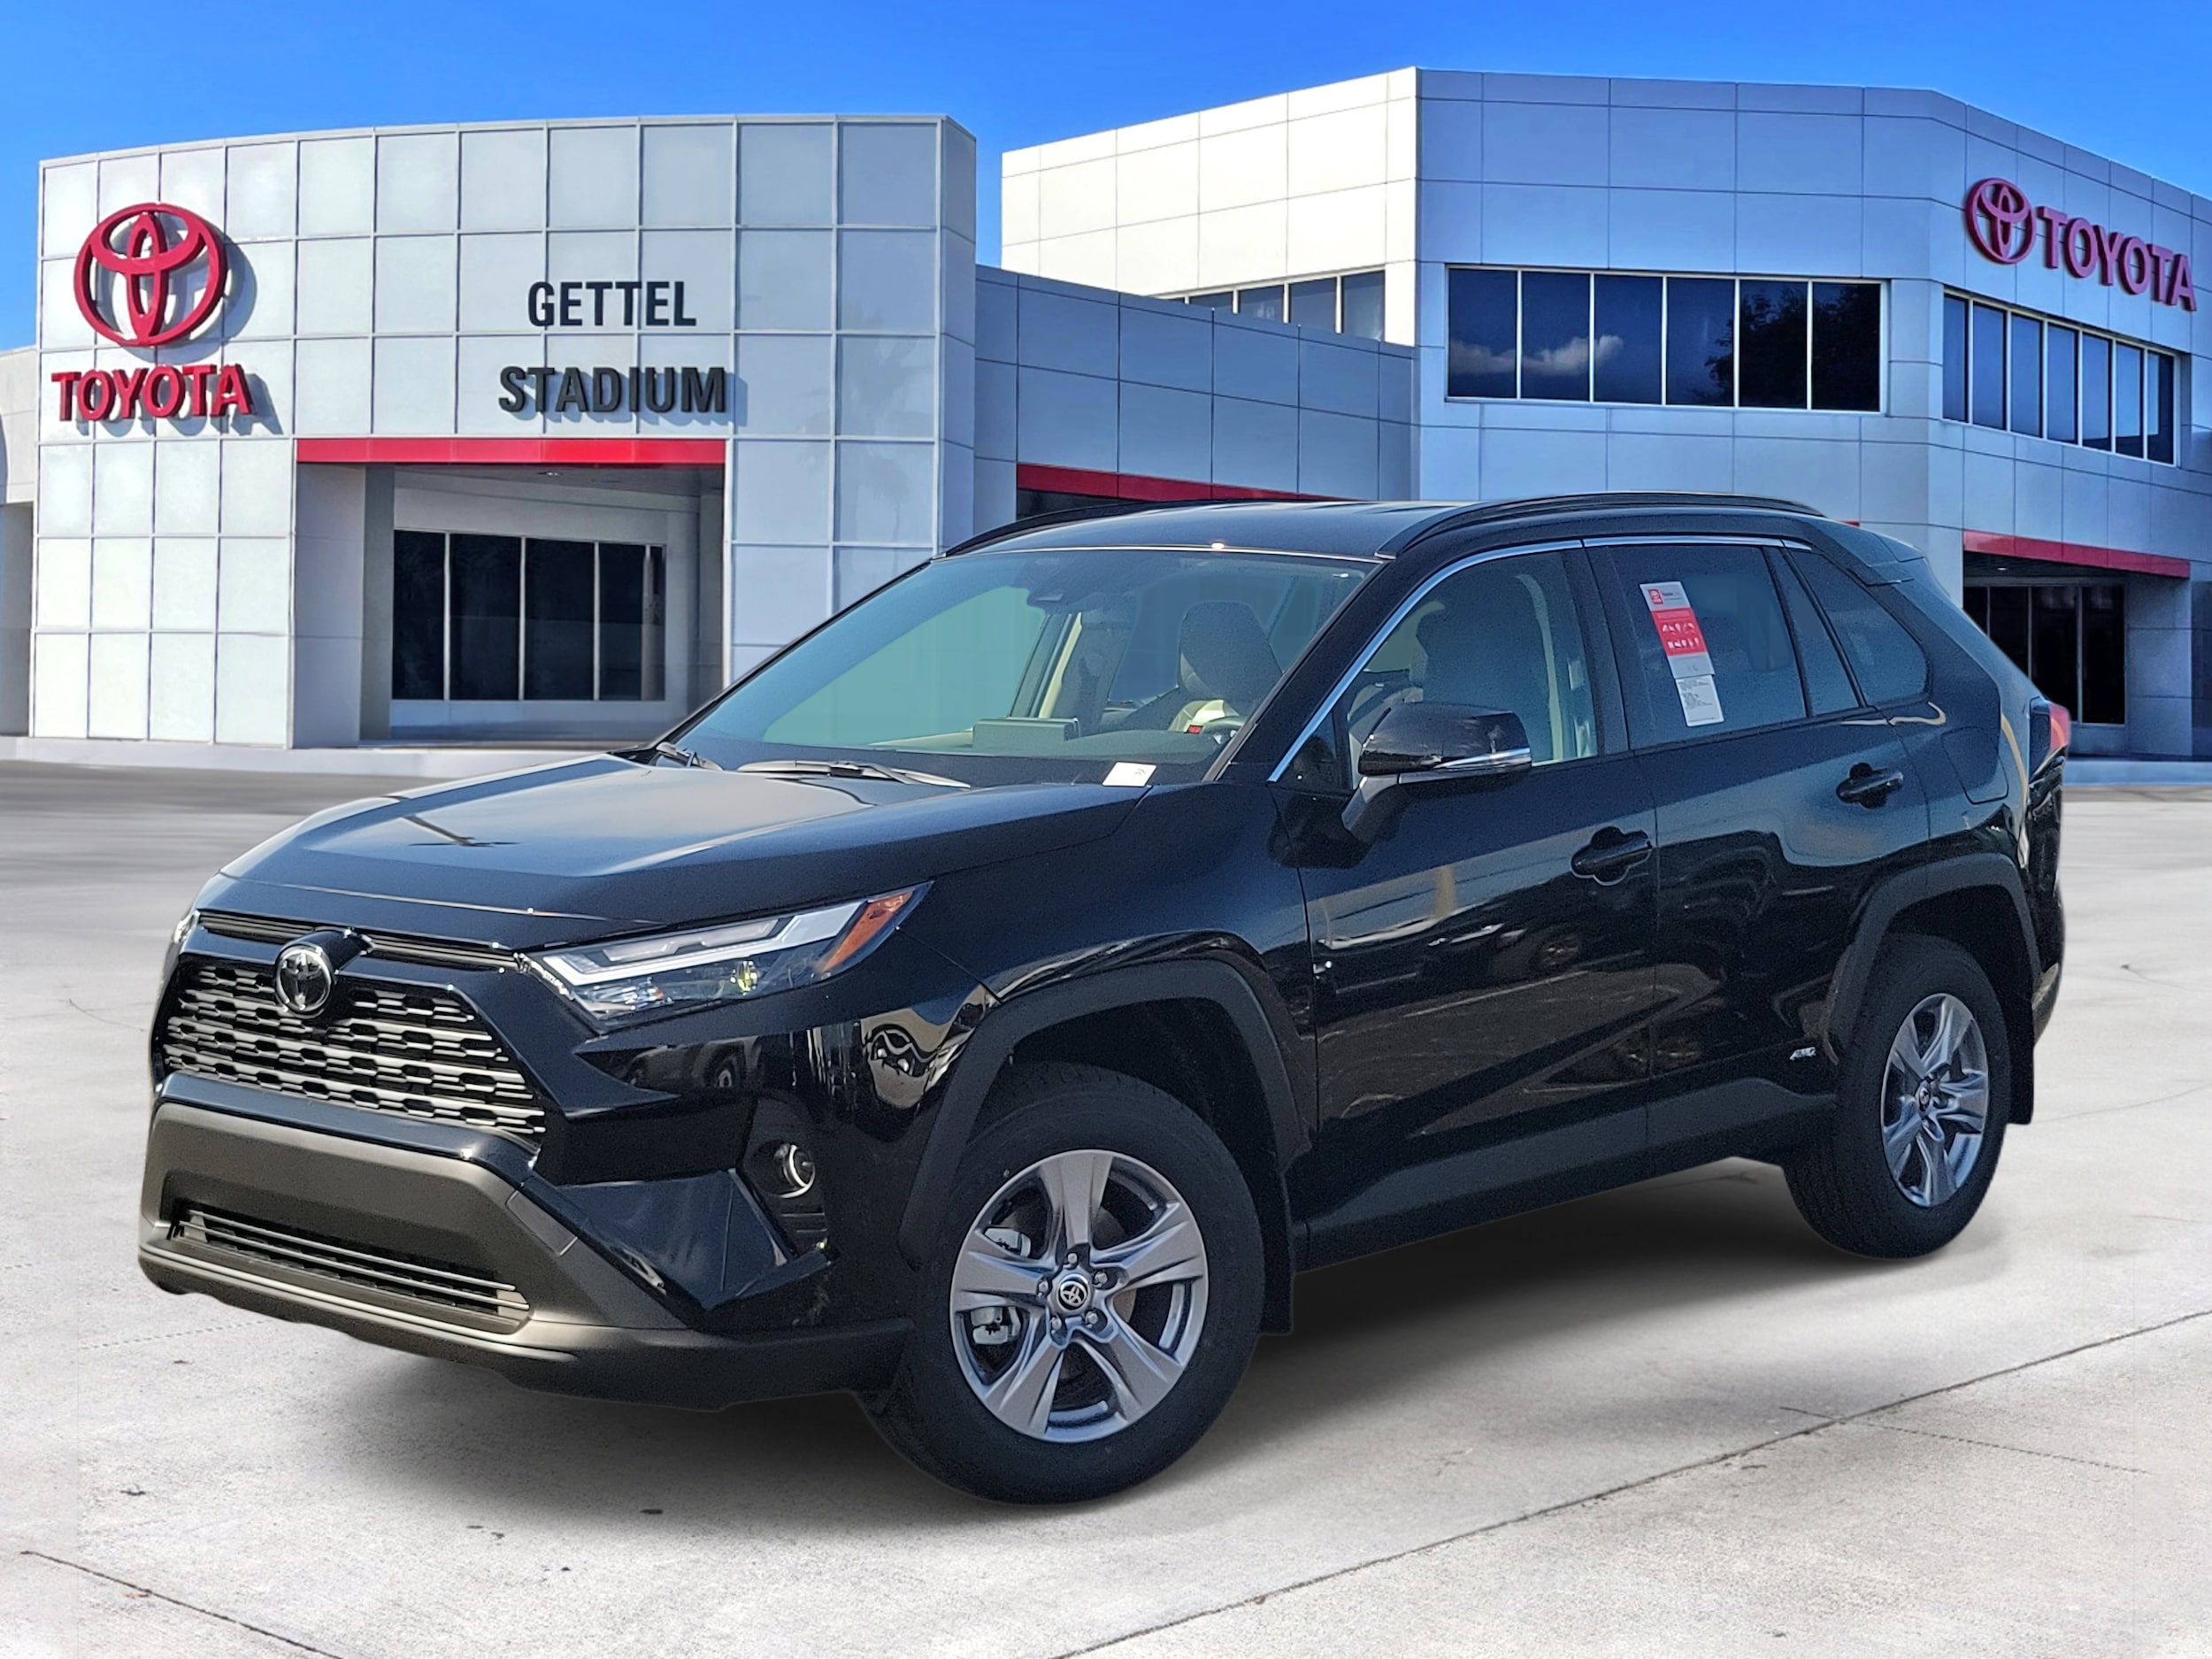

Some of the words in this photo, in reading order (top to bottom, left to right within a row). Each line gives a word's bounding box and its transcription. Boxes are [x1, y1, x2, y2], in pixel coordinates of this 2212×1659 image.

[2037, 205, 2197, 311] TOYOTA
[528, 281, 697, 326] GETTEL
[51, 363, 253, 421] TOYOTA
[498, 366, 726, 413] STADIUM
